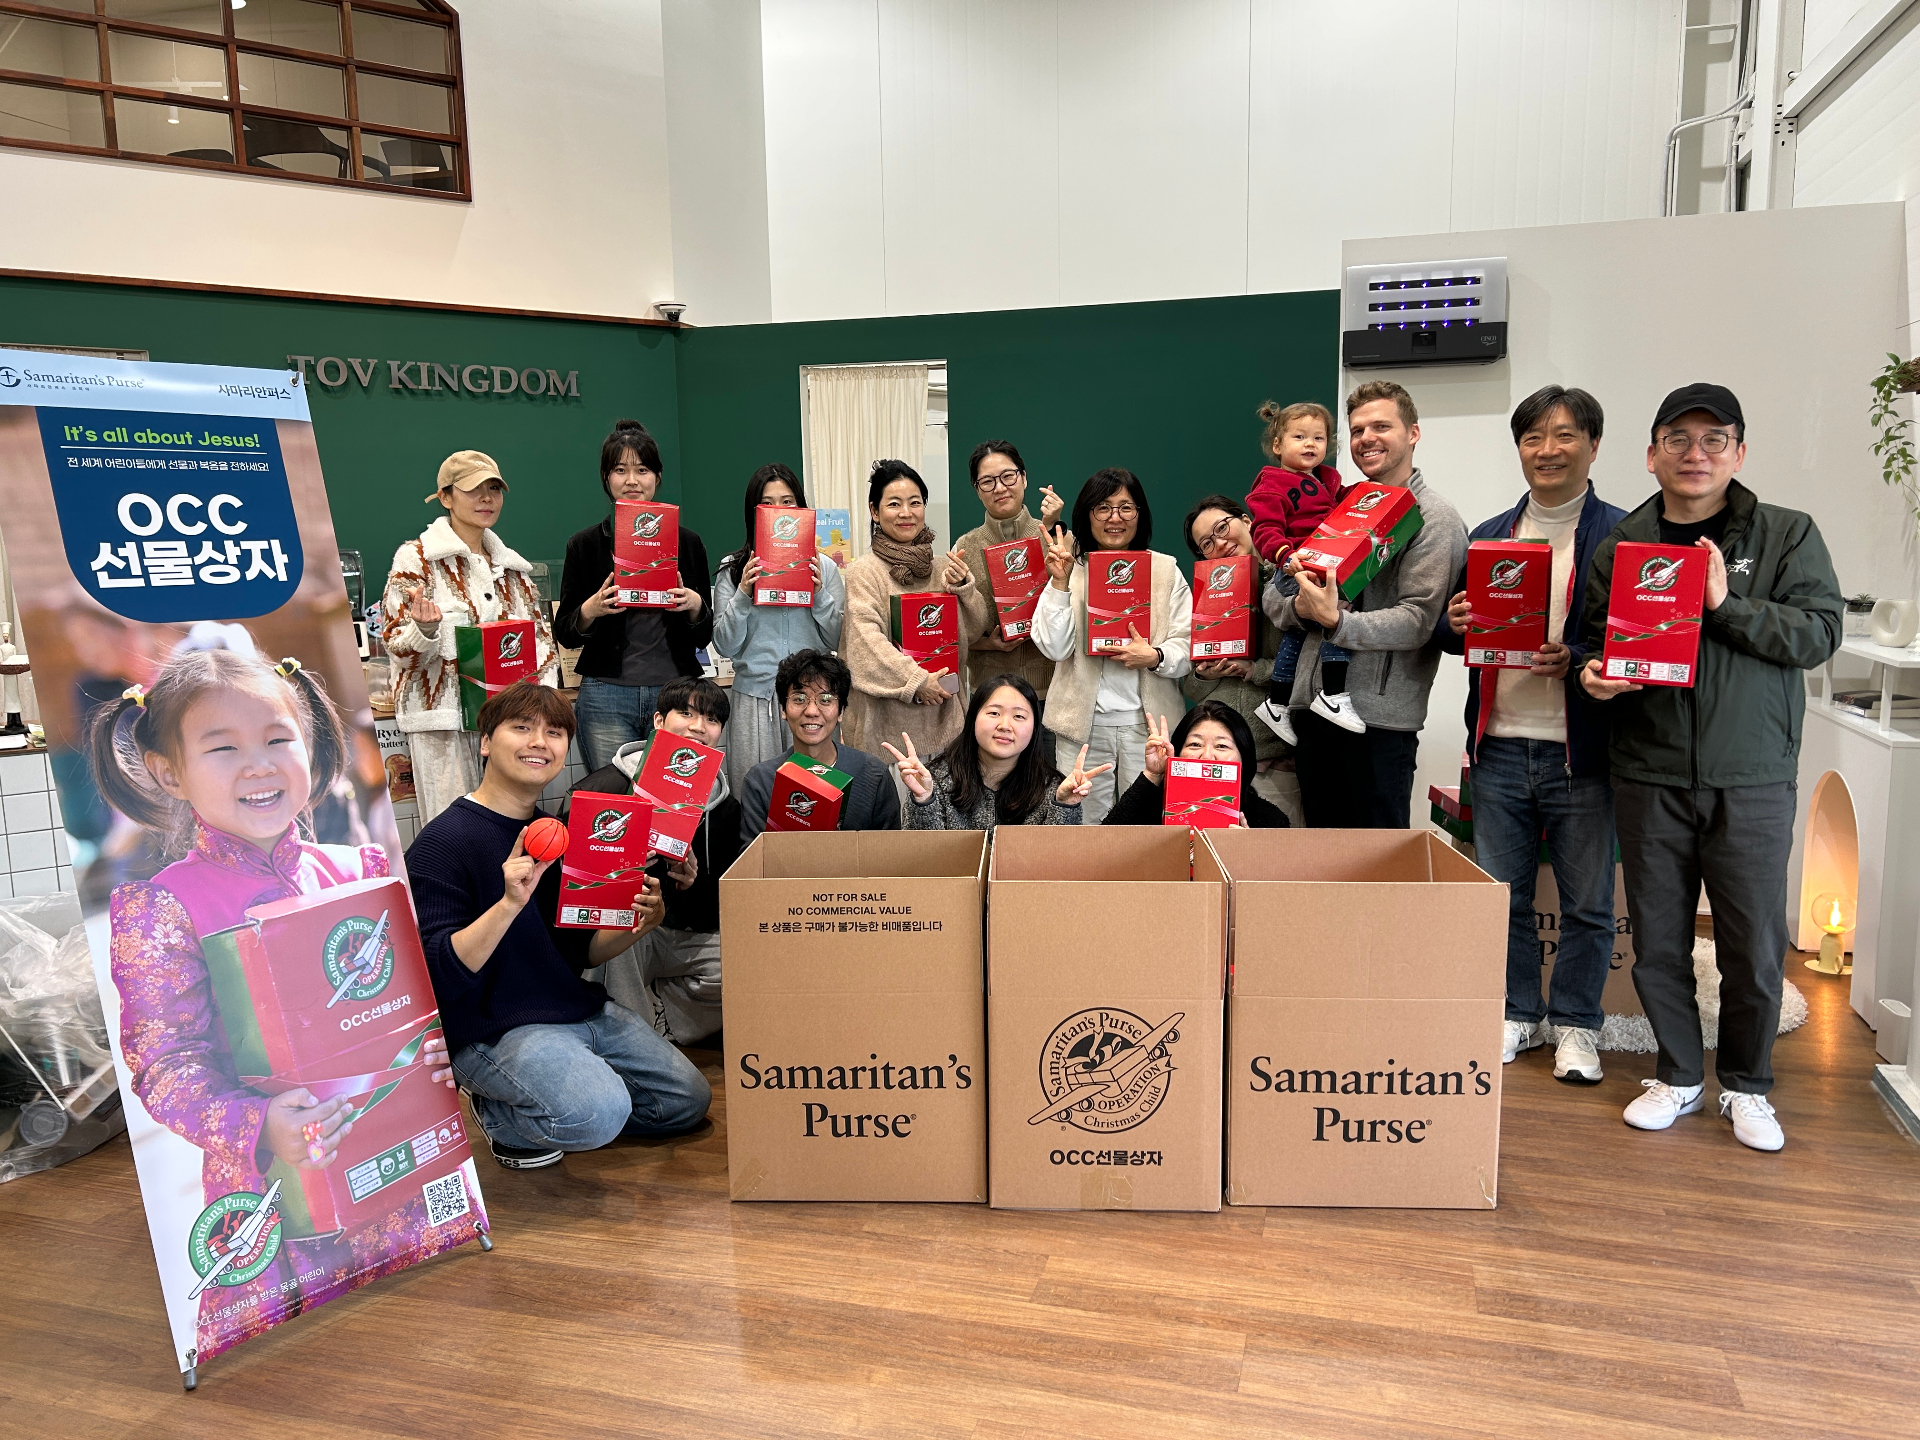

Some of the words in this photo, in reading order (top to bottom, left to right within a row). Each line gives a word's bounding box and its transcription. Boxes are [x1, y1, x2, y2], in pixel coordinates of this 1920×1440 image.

[23, 369, 105, 386] Samaritan's
[106, 375, 144, 389] Purse
[218, 384, 292, 400] 사마리안퍼스
[287, 354, 378, 388] TOV
[387, 360, 580, 397] KINGDOM
[64, 425, 98, 441] It's
[102, 427, 129, 443] all
[133, 429, 193, 445] about
[198, 431, 260, 448] Jesus!
[66, 457, 79, 468] 전
[81, 457, 102, 469] 세계
[104, 458, 166, 470] 어린이들에게
[168, 459, 198, 471] 선물과
[199, 460, 229, 471] 복음을
[229, 461, 270, 472] 전하세요!
[117, 492, 248, 537] OCC
[816, 518, 827, 526] eal
[90, 539, 289, 589] 선물상자
[377, 729, 400, 740] Rye
[788, 907, 803, 916] NO
[805, 907, 876, 915] COMMERCIAL
[879, 906, 912, 915] VALUE
[812, 893, 834, 902] NOT
[836, 893, 858, 902] FOR
[860, 893, 887, 902] SALE
[759, 922, 769, 933] 본
[771, 922, 802, 933] 상품은
[804, 922, 835, 933] 구매가
[838, 921, 879, 932] 불가능한
[881, 921, 943, 932] 비매품입니다
[327, 924, 348, 986] Samaritan's
[346, 919, 373, 933] Purse
[362, 944, 388, 985] OPERATION
[356, 978, 387, 998] Christmas
[383, 958, 392, 978] Child
[340, 994, 411, 1031] OCC선물상자
[740, 1053, 972, 1090] Samaritan's
[1050, 1017, 1096, 1098] Samaritan's
[1098, 1012, 1143, 1040] Purse
[1098, 1064, 1161, 1111] OPERATION
[1250, 1056, 1491, 1096] Samaritan's
[802, 1102, 912, 1138] Purse
[1084, 1112, 1141, 1129] Christmas
[1139, 1085, 1161, 1113] Child
[1312, 1106, 1427, 1144] Purse
[1050, 1149, 1163, 1166] OCC선물상자
[195, 1204, 224, 1273] Samaritan's
[223, 1197, 258, 1211] Purse
[236, 1219, 276, 1268] OPERATION
[229, 1258, 269, 1283] Christmas
[266, 1234, 279, 1257] Child
[193, 1295, 259, 1330] OCC선물상자를
[260, 1286, 279, 1302] 받은
[299, 1266, 325, 1283] 어린이
